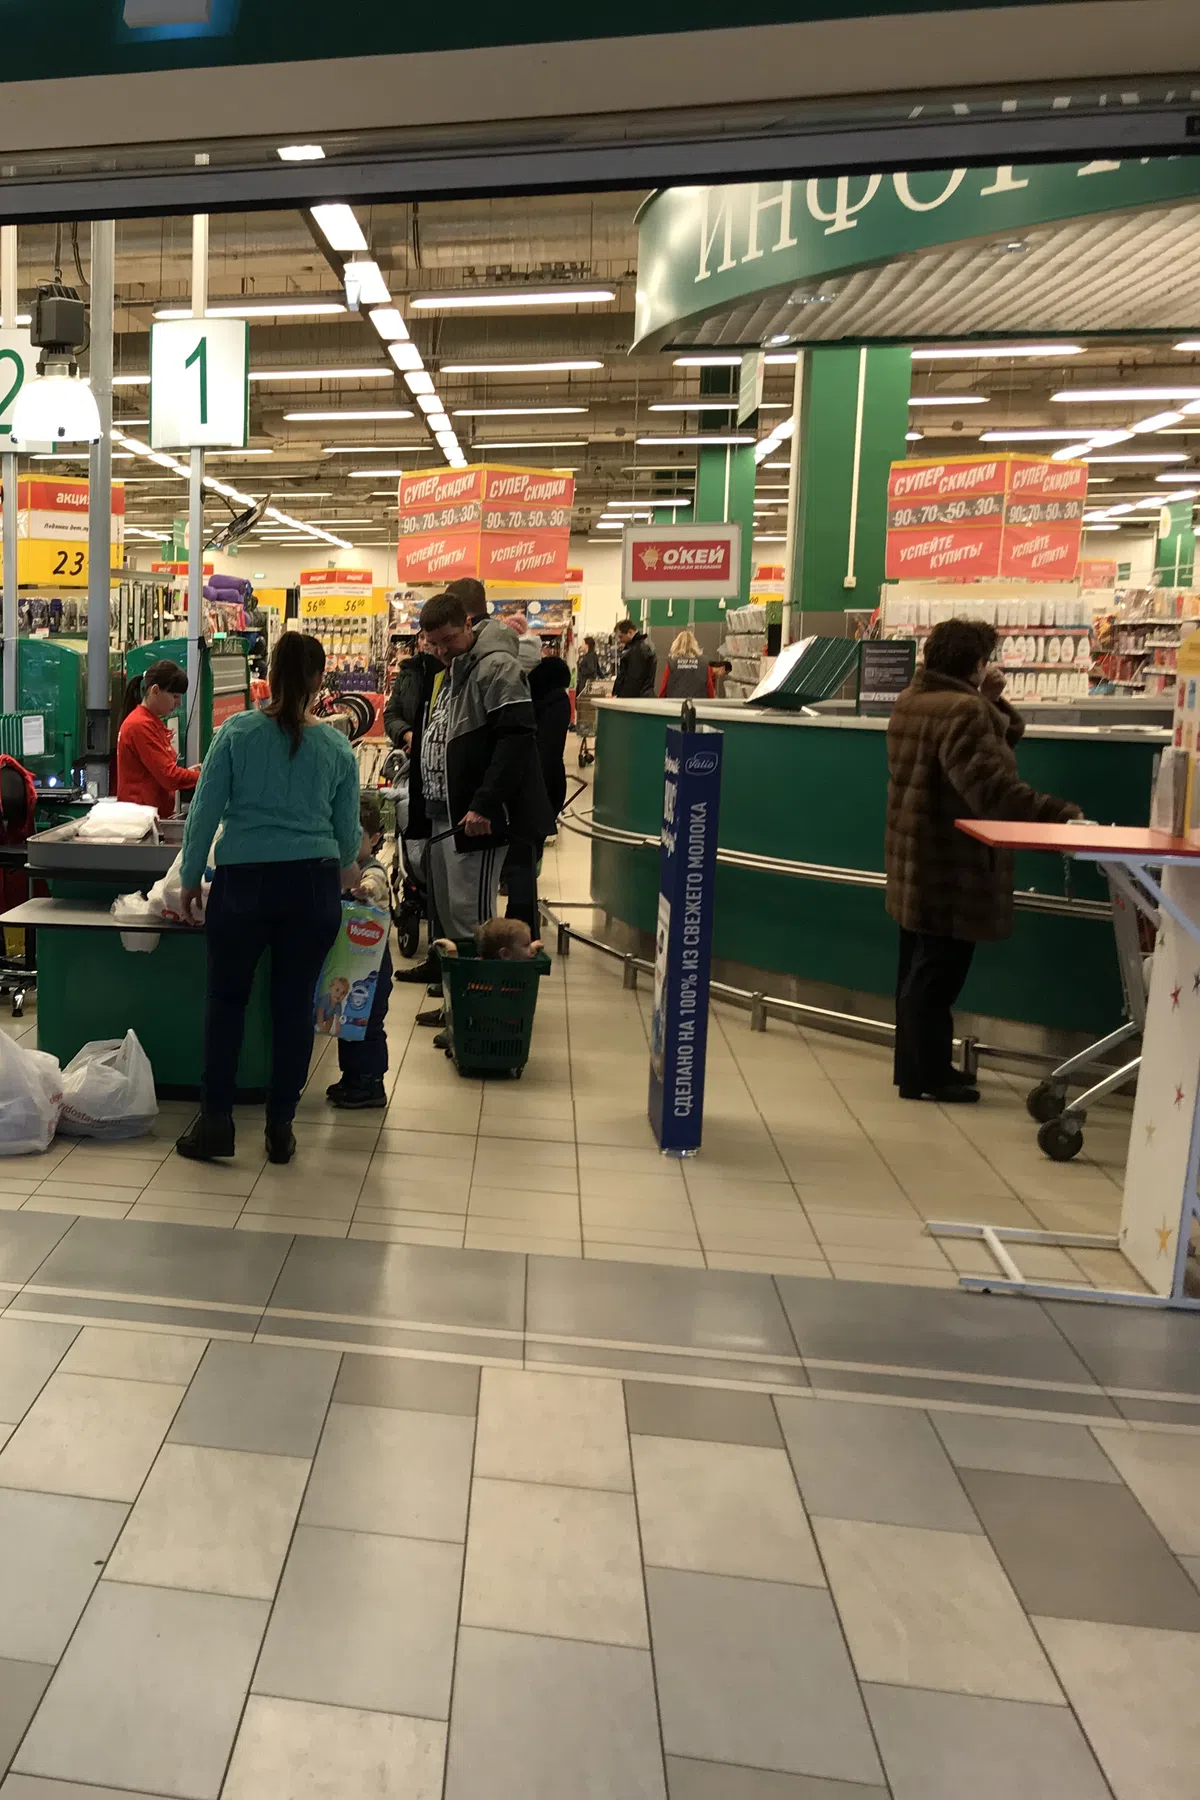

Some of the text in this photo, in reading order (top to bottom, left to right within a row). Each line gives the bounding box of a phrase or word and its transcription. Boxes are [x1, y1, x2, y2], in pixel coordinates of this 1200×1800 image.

[185, 336, 208, 425] 1
[403, 472, 476, 505] СУПЕР СКИДКИ
[489, 474, 566, 502] СУПЕР СКИДКИ
[894, 462, 997, 496] СУПЕР СКИДКИ
[1012, 464, 1082, 492] СУПЕР СКИДКИ
[56, 491, 89, 507] акци
[405, 540, 446, 568] УСПЕЙТЕ
[427, 546, 467, 573] КУПИТЬ!
[490, 540, 536, 564] УСПЕЙТЕ
[899, 534, 955, 562] УСПЕЙТЕ
[929, 541, 984, 569] КУПИТЬ!
[1010, 534, 1051, 560] УСПЕЙТЕ
[52, 550, 86, 576] 23
[514, 550, 557, 573] КУПИТЬ!
[687, 758, 714, 770] Valio
[673, 801, 708, 1118] СДЕЛАНО НА 100% ИЗ СВЕЖЕГО МОЛОКА
